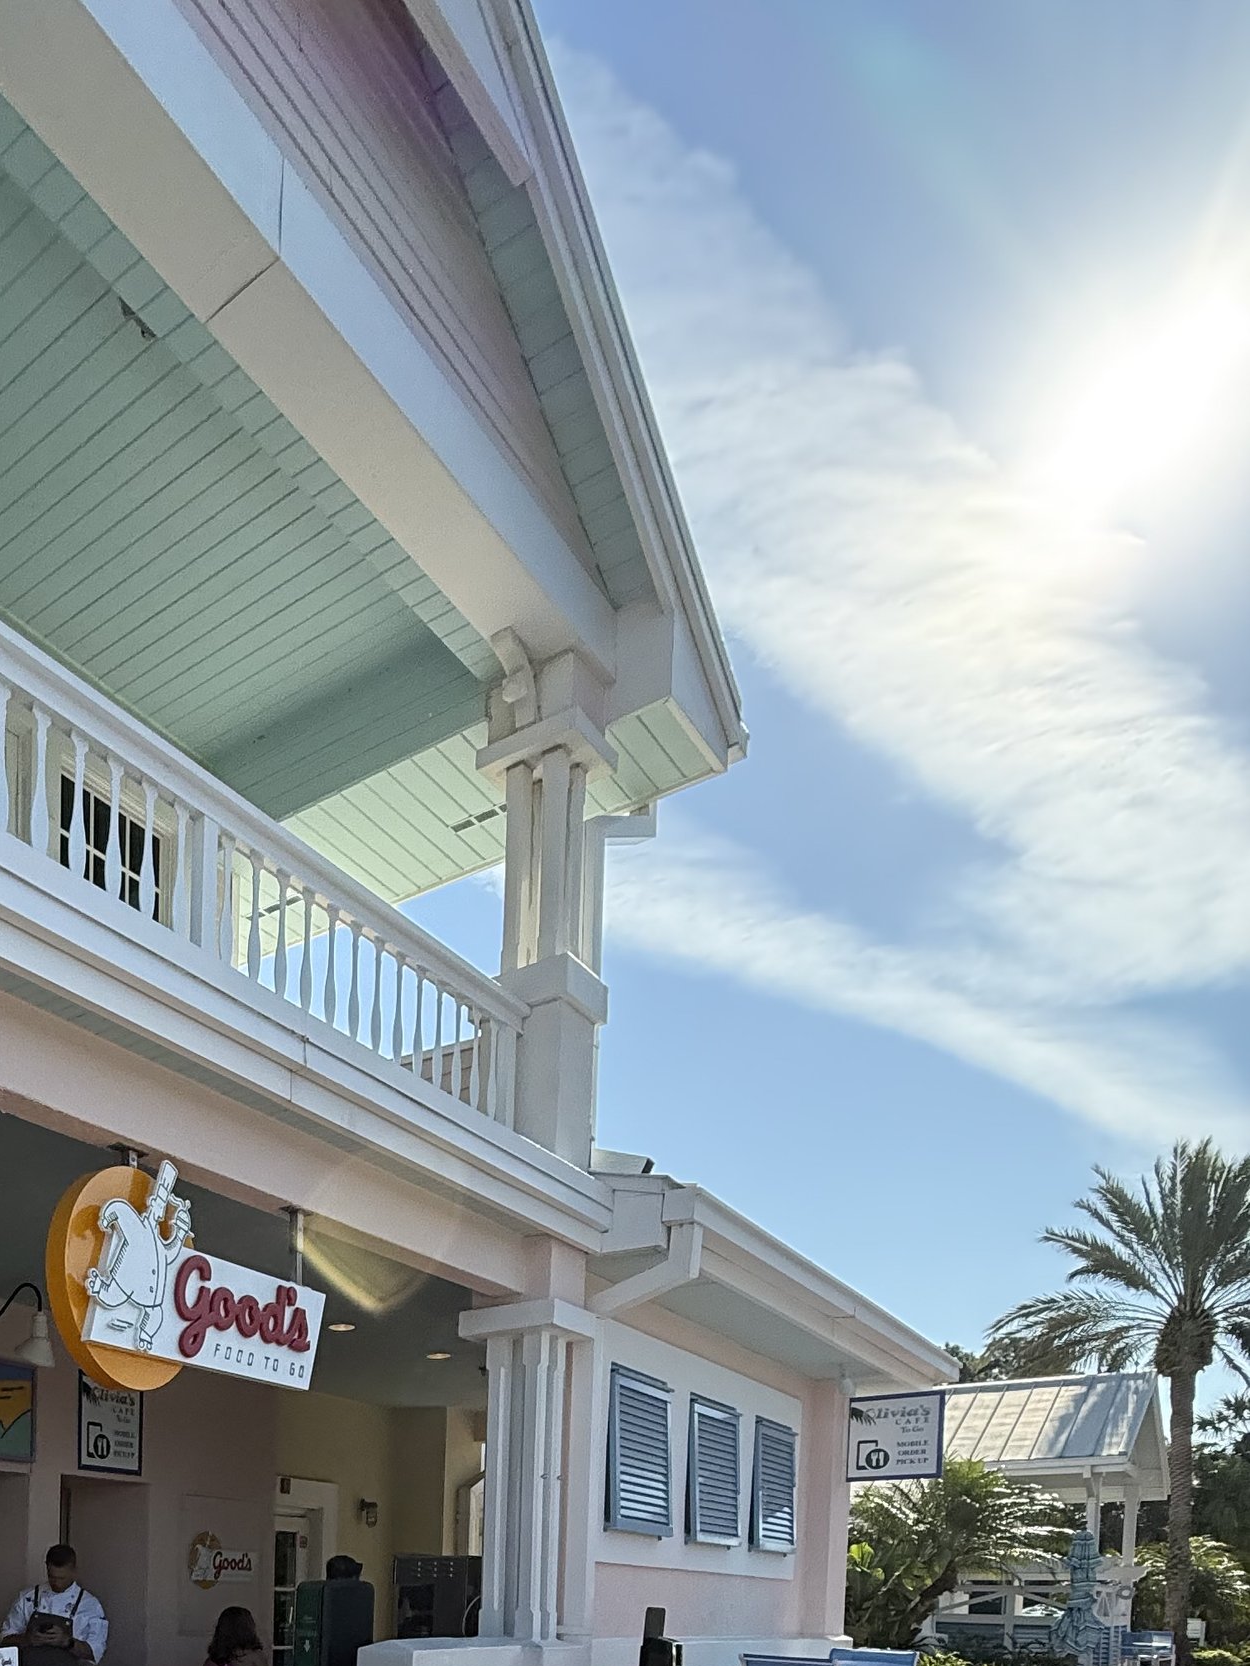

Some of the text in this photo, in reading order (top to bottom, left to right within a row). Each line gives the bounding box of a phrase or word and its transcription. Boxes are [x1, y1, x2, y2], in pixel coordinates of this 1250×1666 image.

[174, 1255, 310, 1358] Good's
[214, 1343, 305, 1378] FOOD TO GO
[865, 1405, 931, 1419] Olivia's
[897, 1440, 929, 1448] MOBILE
[898, 1449, 926, 1457] ORDER
[213, 1551, 252, 1580] Good's
